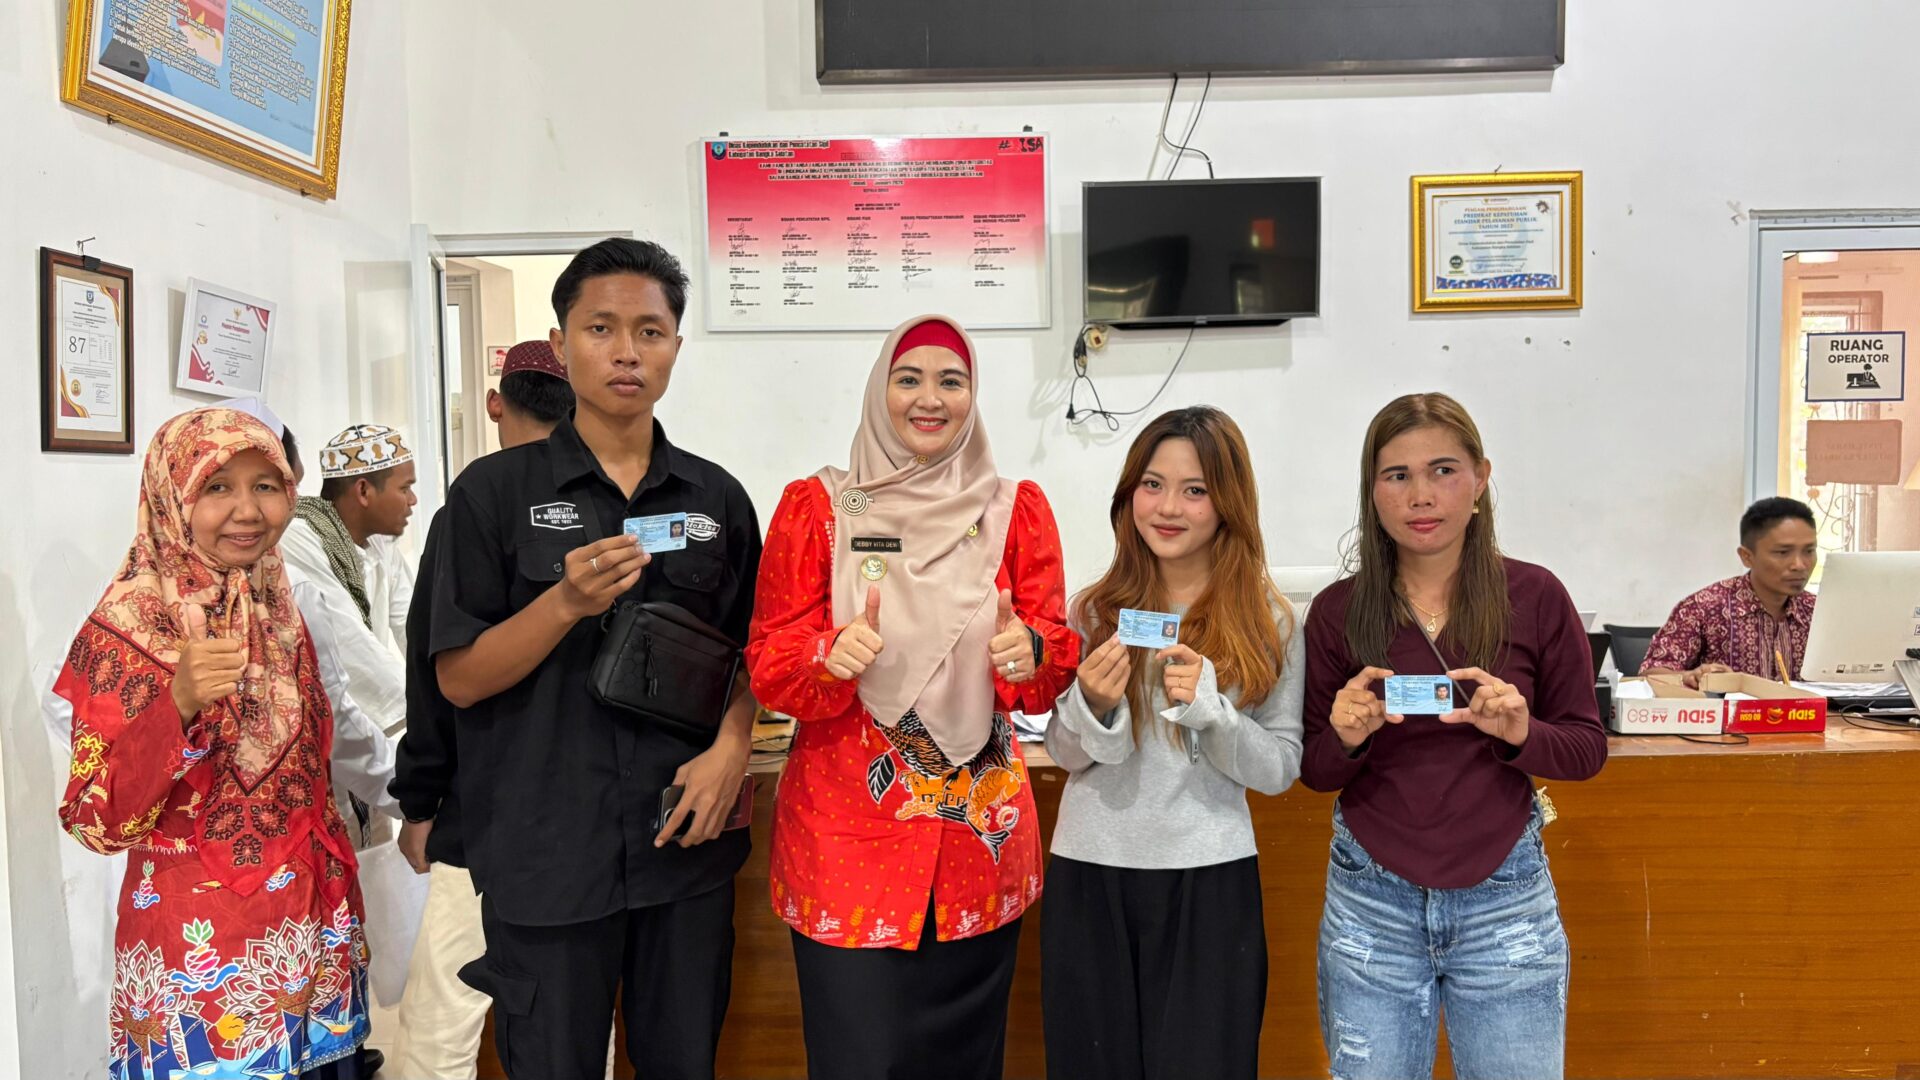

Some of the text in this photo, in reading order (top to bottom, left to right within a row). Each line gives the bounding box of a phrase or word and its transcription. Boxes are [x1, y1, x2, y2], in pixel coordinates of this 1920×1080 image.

[68, 335, 86, 354] 87
[1830, 339, 1884, 351] RUANG
[1828, 353, 1889, 364] OPERATOR
[1627, 708, 1649, 723] 80
[1651, 714, 1668, 723] A4
